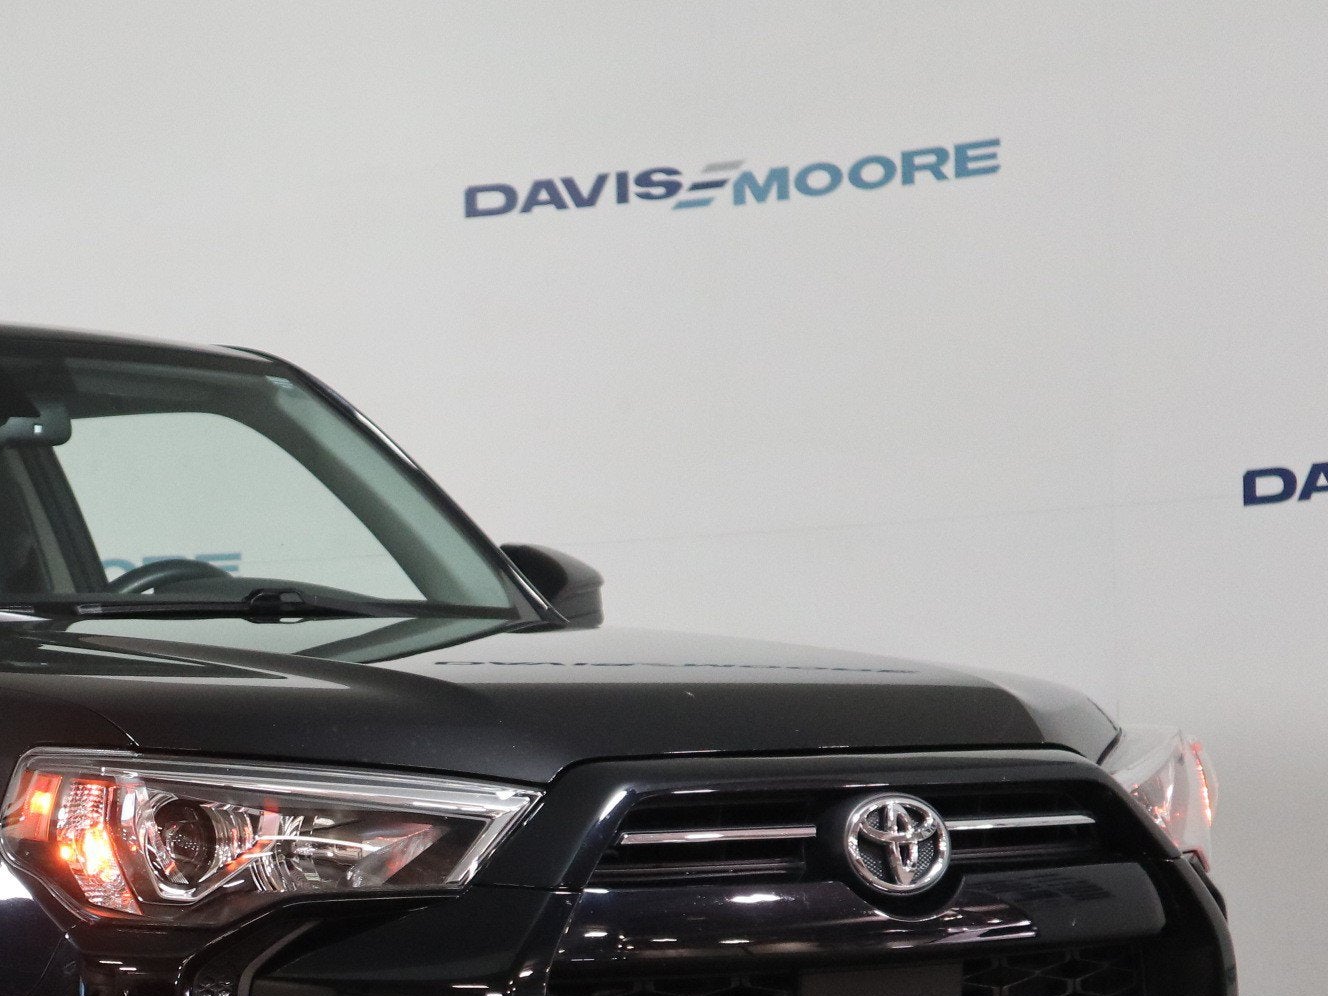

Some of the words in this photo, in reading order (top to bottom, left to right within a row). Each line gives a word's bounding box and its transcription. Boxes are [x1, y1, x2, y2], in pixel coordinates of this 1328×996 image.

[464, 167, 682, 219] DAVIS
[732, 137, 1001, 206] MOORE
[1242, 461, 1328, 507] DA
